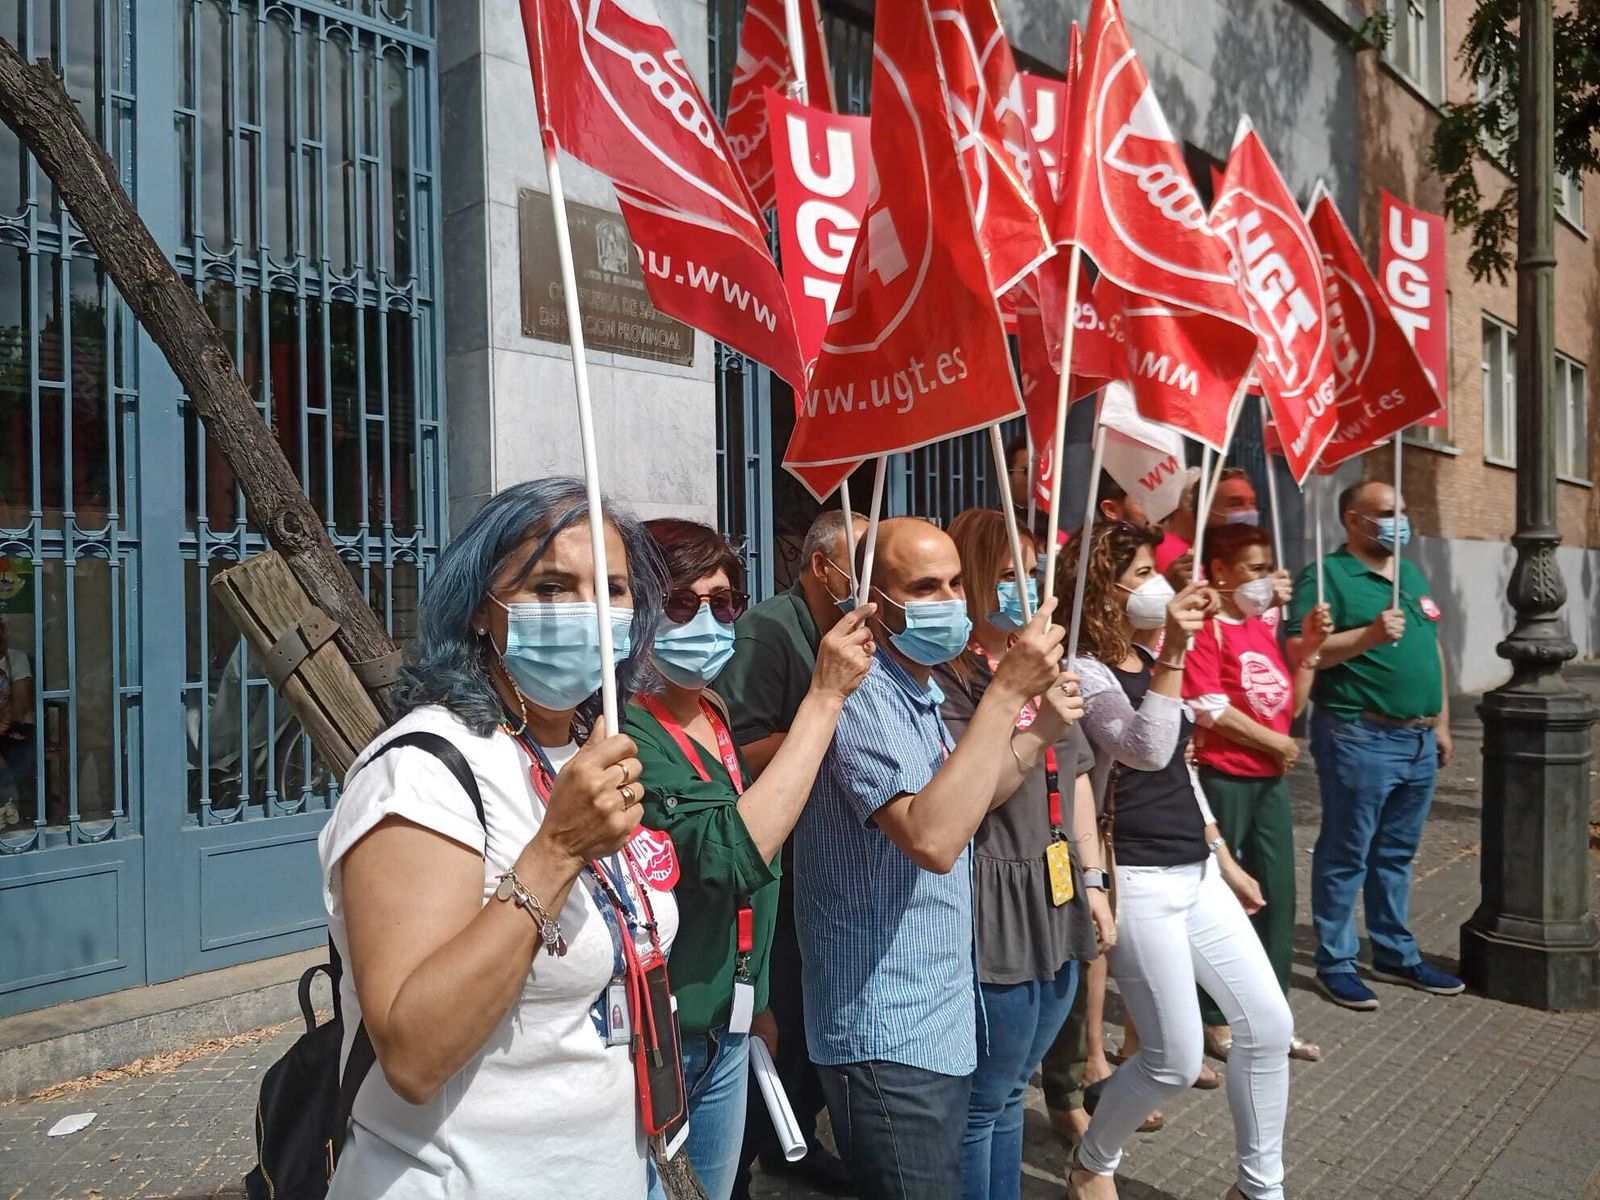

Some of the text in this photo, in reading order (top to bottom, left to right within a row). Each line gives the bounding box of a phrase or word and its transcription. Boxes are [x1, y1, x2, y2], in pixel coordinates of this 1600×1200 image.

[1237, 210, 1320, 348] UGT
[1386, 205, 1431, 347] UGT
[617, 321, 682, 351] PROVINCIAL
[628, 830, 660, 868] UGT
